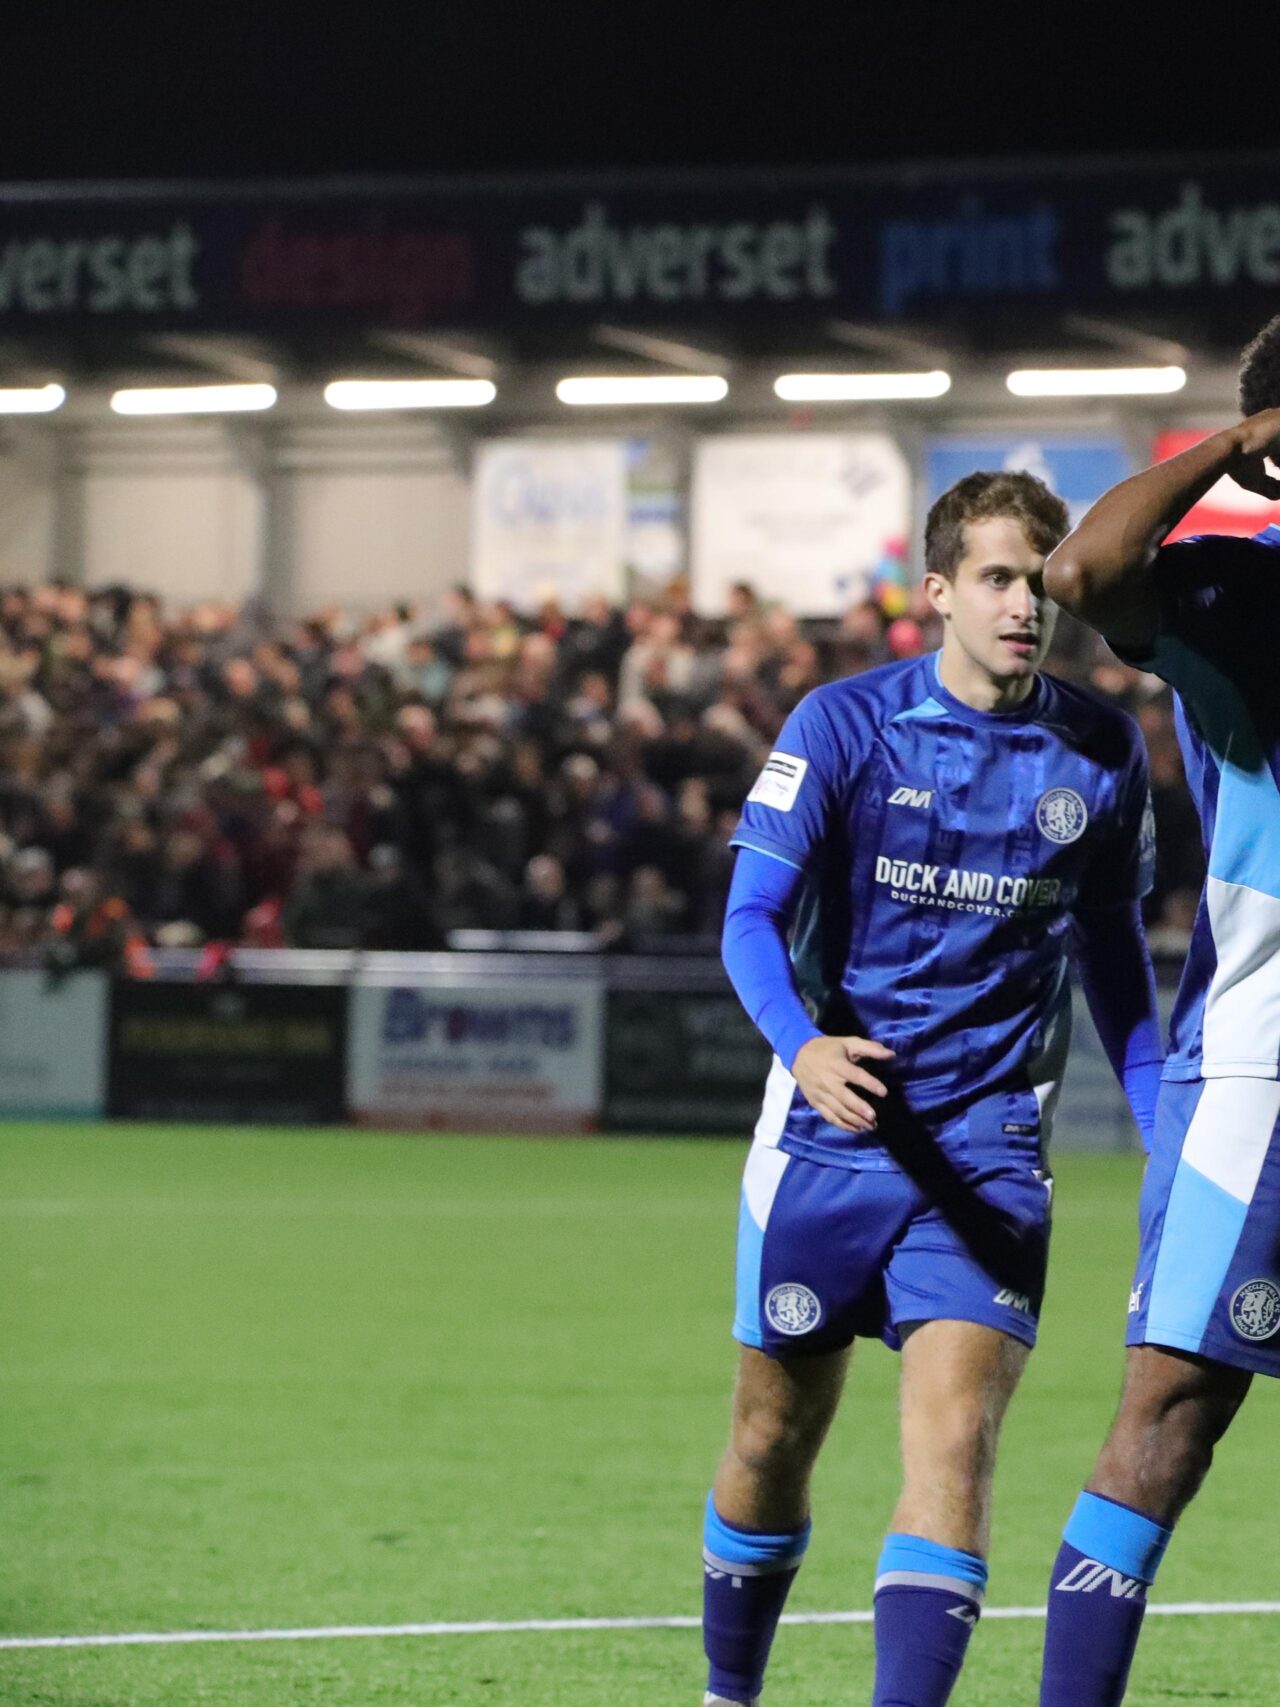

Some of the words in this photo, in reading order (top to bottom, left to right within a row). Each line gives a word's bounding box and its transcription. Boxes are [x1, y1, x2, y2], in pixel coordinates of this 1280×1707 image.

[516, 206, 836, 302] adverset
[880, 198, 1059, 312] print
[942, 869, 994, 902] AND
